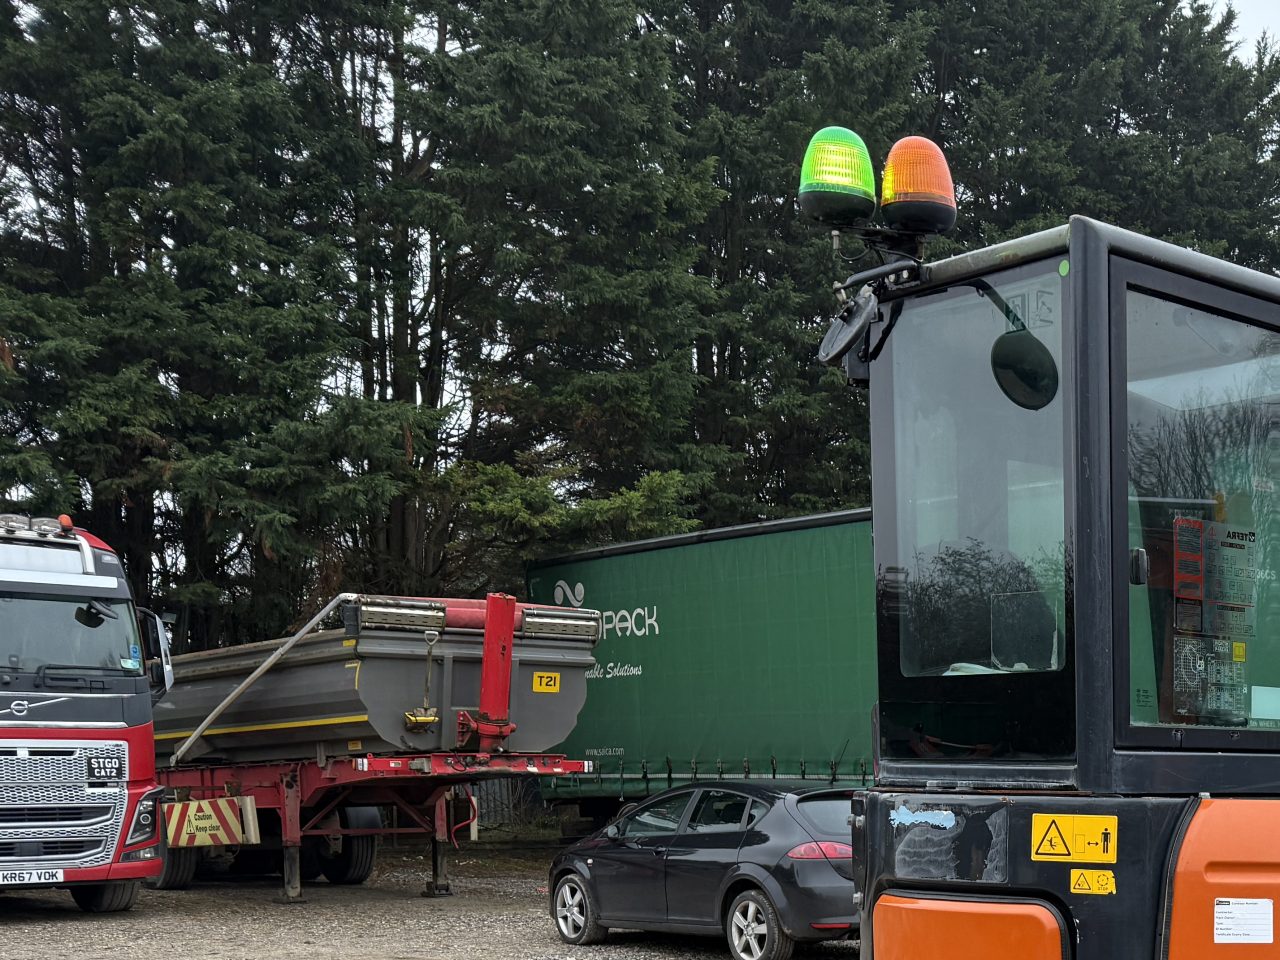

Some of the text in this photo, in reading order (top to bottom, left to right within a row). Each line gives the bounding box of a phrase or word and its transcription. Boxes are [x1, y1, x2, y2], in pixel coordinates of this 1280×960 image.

[599, 605, 660, 640] PACK
[584, 662, 642, 679] nable Solutions
[537, 675, 557, 687] T21
[585, 747, 625, 756] www.saica.com
[91, 758, 119, 768] STGO
[94, 768, 117, 777] CAT2
[193, 813, 213, 822] Caution
[195, 824, 220, 834] Keep clear
[2, 871, 59, 883] KR67 VOK
